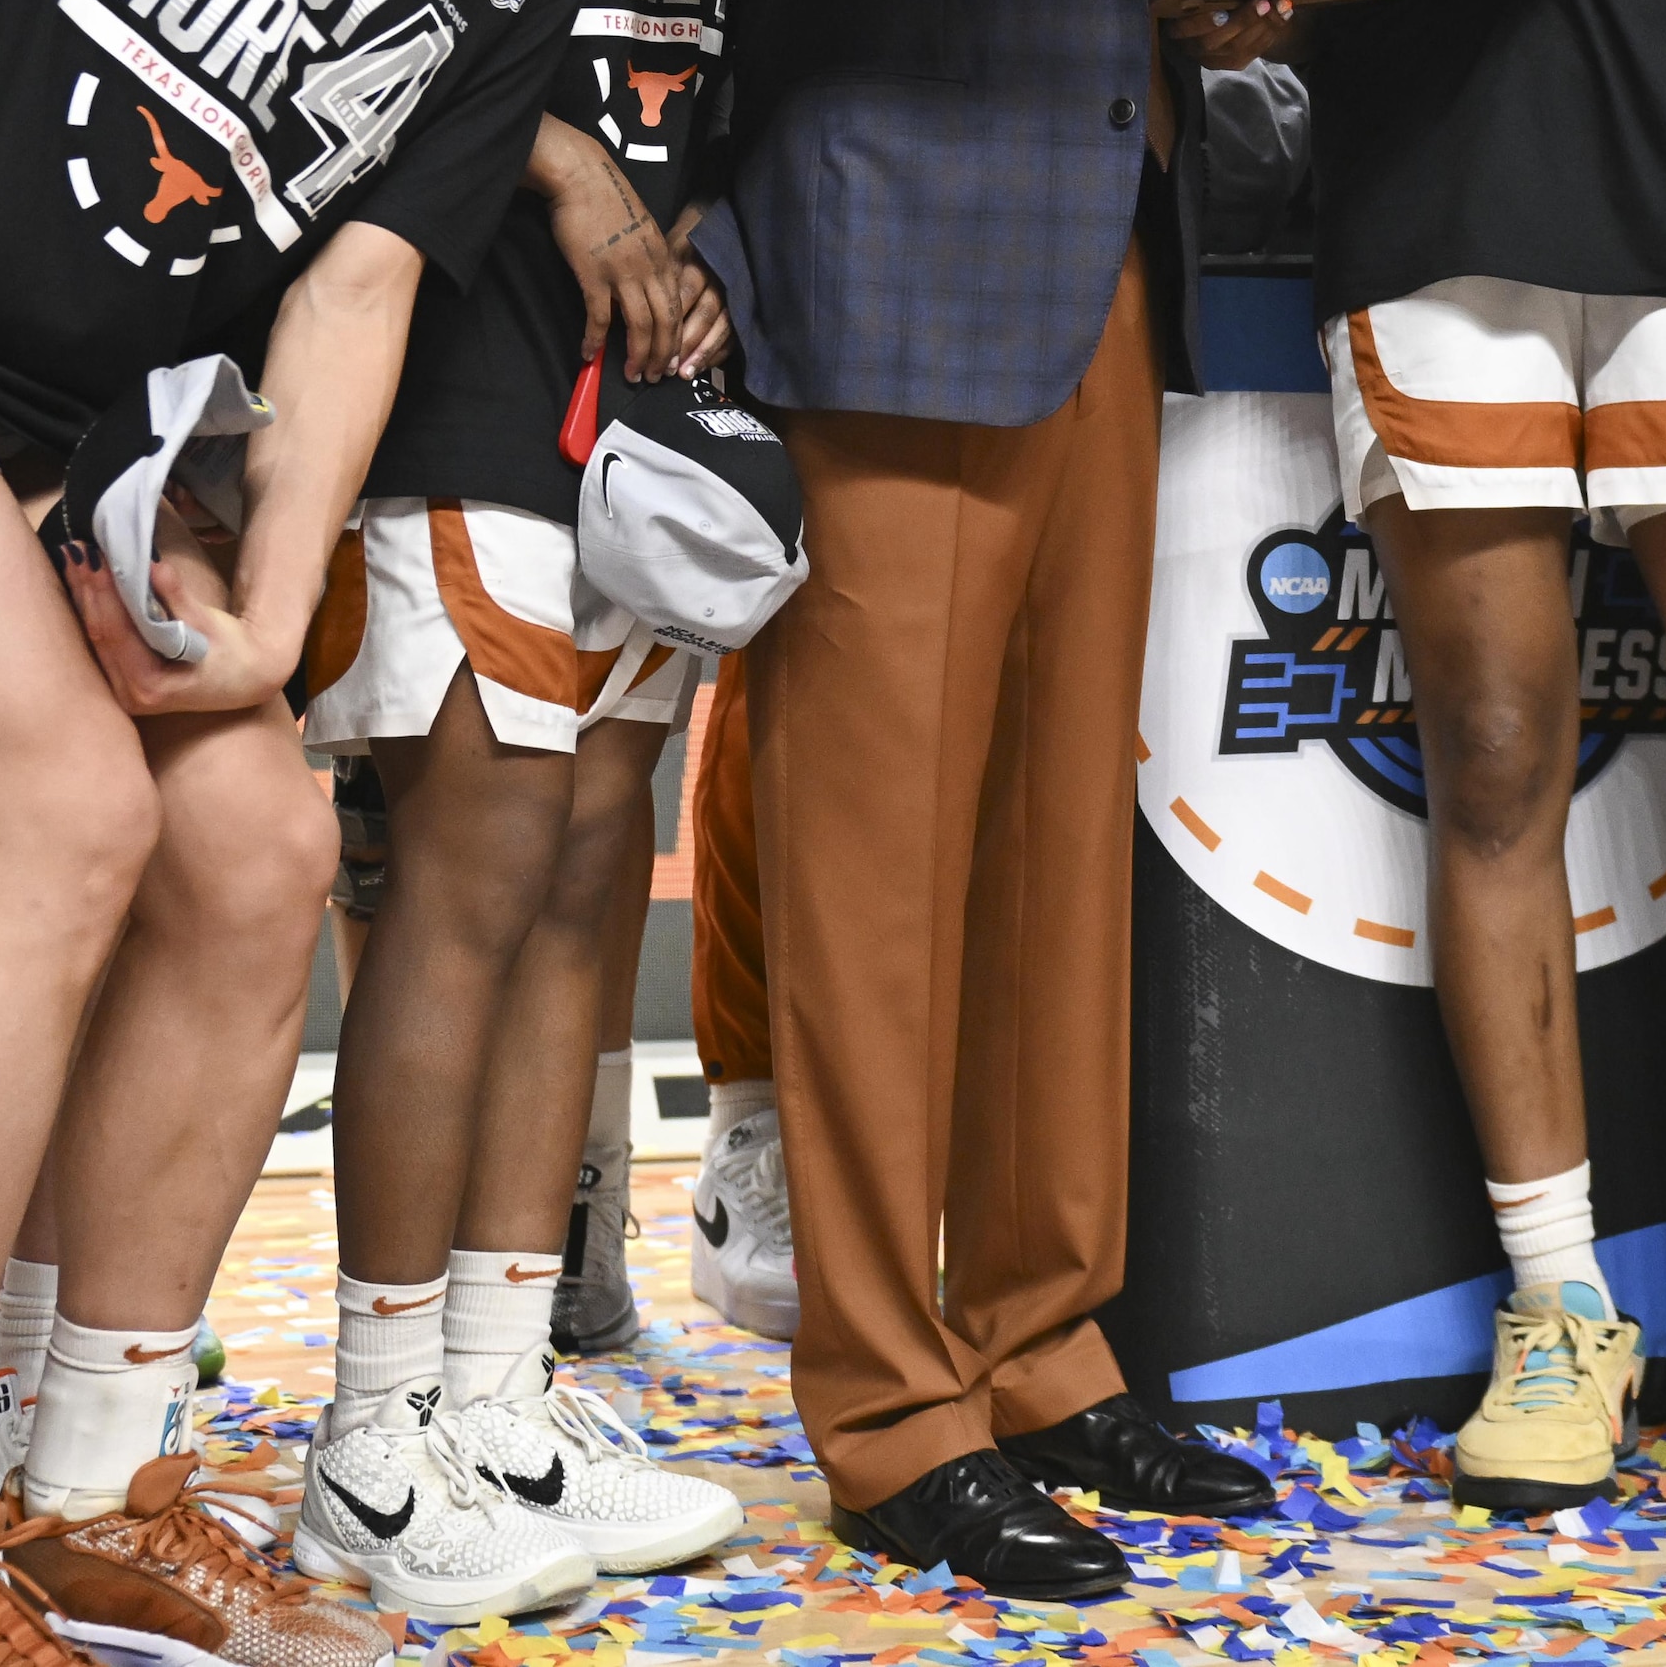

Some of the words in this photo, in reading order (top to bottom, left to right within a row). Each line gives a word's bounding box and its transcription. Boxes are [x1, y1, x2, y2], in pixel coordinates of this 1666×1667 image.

[120, 37, 187, 99] TEXAS
[282, 2, 455, 219] 4
[1269, 577, 1328, 595] NCAA
